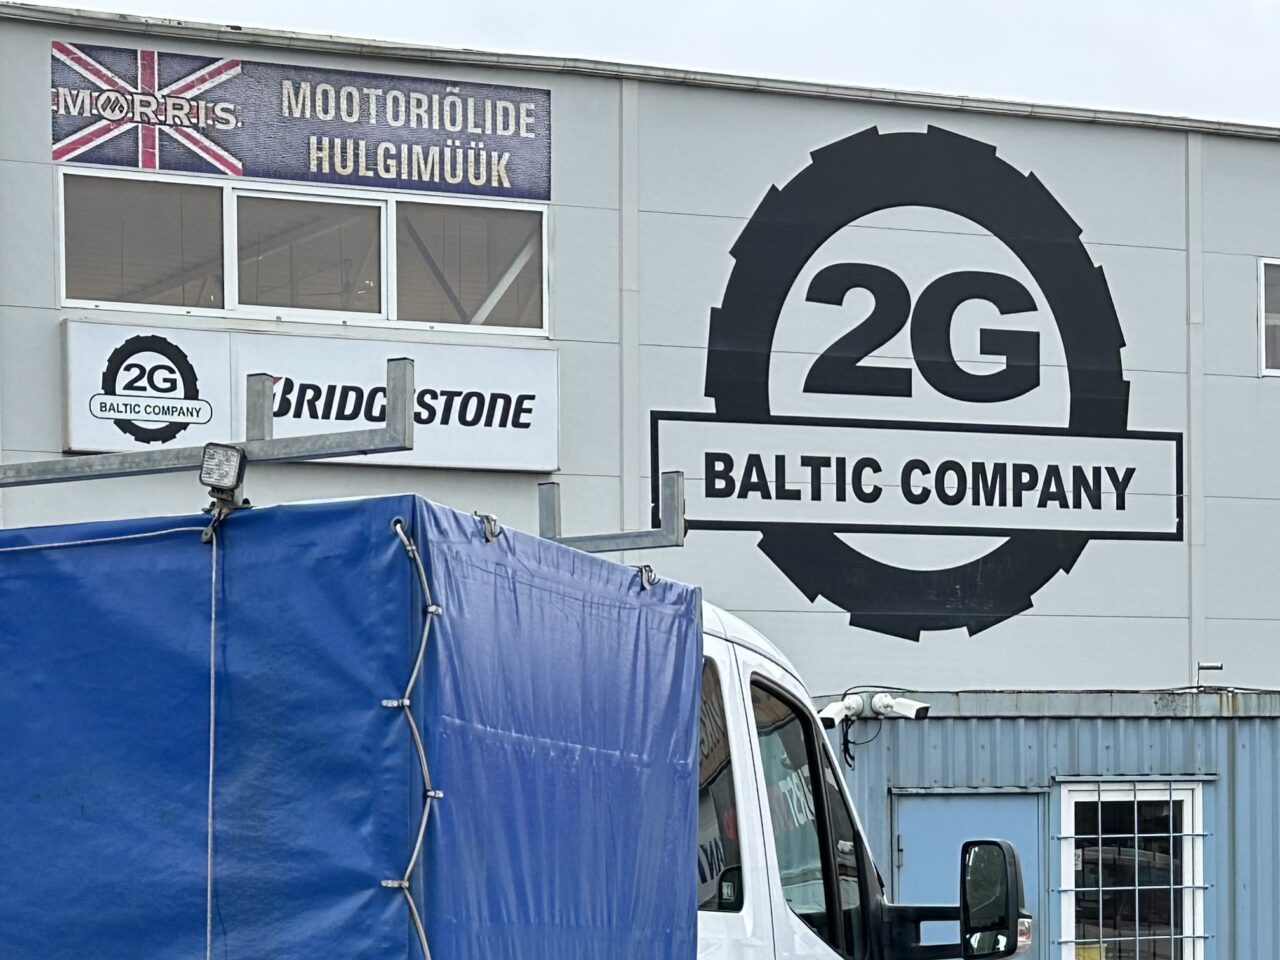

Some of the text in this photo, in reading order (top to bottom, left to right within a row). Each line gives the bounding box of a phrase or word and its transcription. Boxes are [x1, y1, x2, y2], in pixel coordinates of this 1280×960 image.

[280, 79, 537, 138] MOOTORIÕLIDE
[308, 135, 512, 188] HULGIMÜÜK
[802, 262, 1041, 404] 2G
[122, 363, 178, 393] 2G
[272, 377, 537, 429] BRIDGSTONE
[100, 401, 202, 418] BALTIC COMPANY
[703, 452, 1137, 512] BALTIC COMPANY
